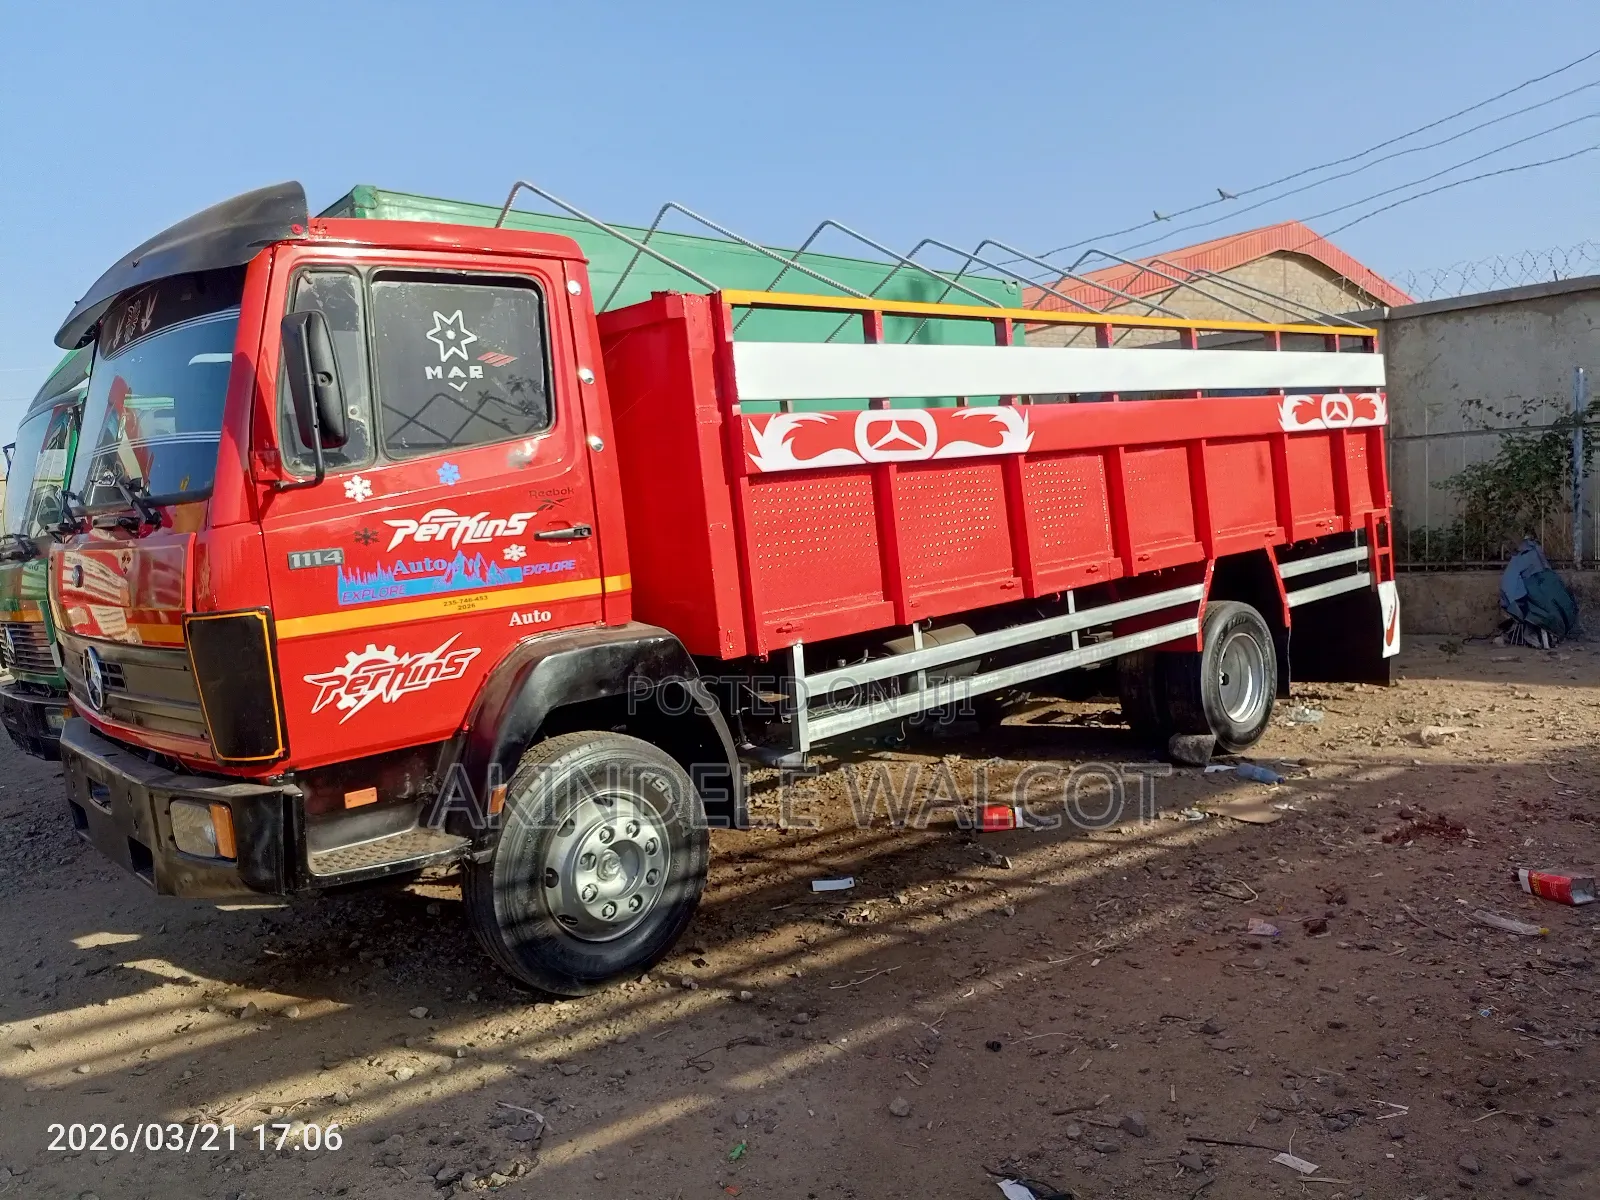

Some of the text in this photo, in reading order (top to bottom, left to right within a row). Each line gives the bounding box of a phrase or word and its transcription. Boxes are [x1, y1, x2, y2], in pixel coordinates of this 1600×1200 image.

[528, 487, 574, 499] Reebok
[291, 550, 343, 568] 1114
[393, 557, 449, 576] Auto
[522, 559, 576, 577] EXPLORE
[342, 584, 405, 602] EXPLORE
[509, 609, 551, 626] Auto
